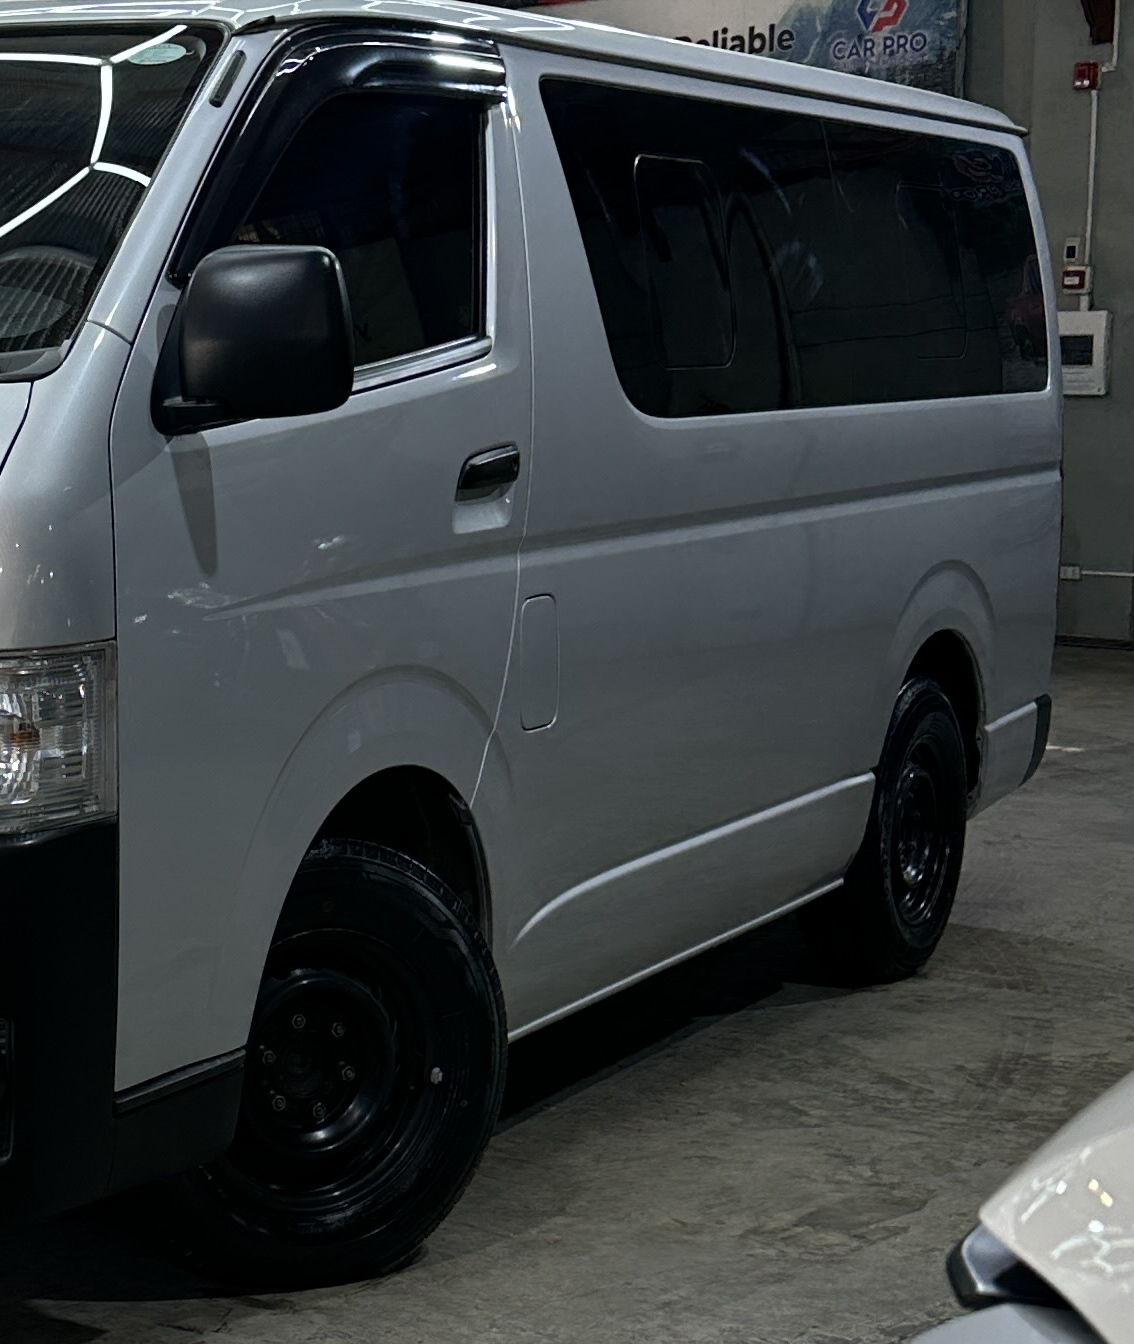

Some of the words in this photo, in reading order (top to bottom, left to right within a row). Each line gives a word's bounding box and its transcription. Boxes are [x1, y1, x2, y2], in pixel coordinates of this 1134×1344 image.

[674, 23, 795, 55] liable
[832, 37, 875, 60] CAR
[883, 32, 927, 55] PRO
